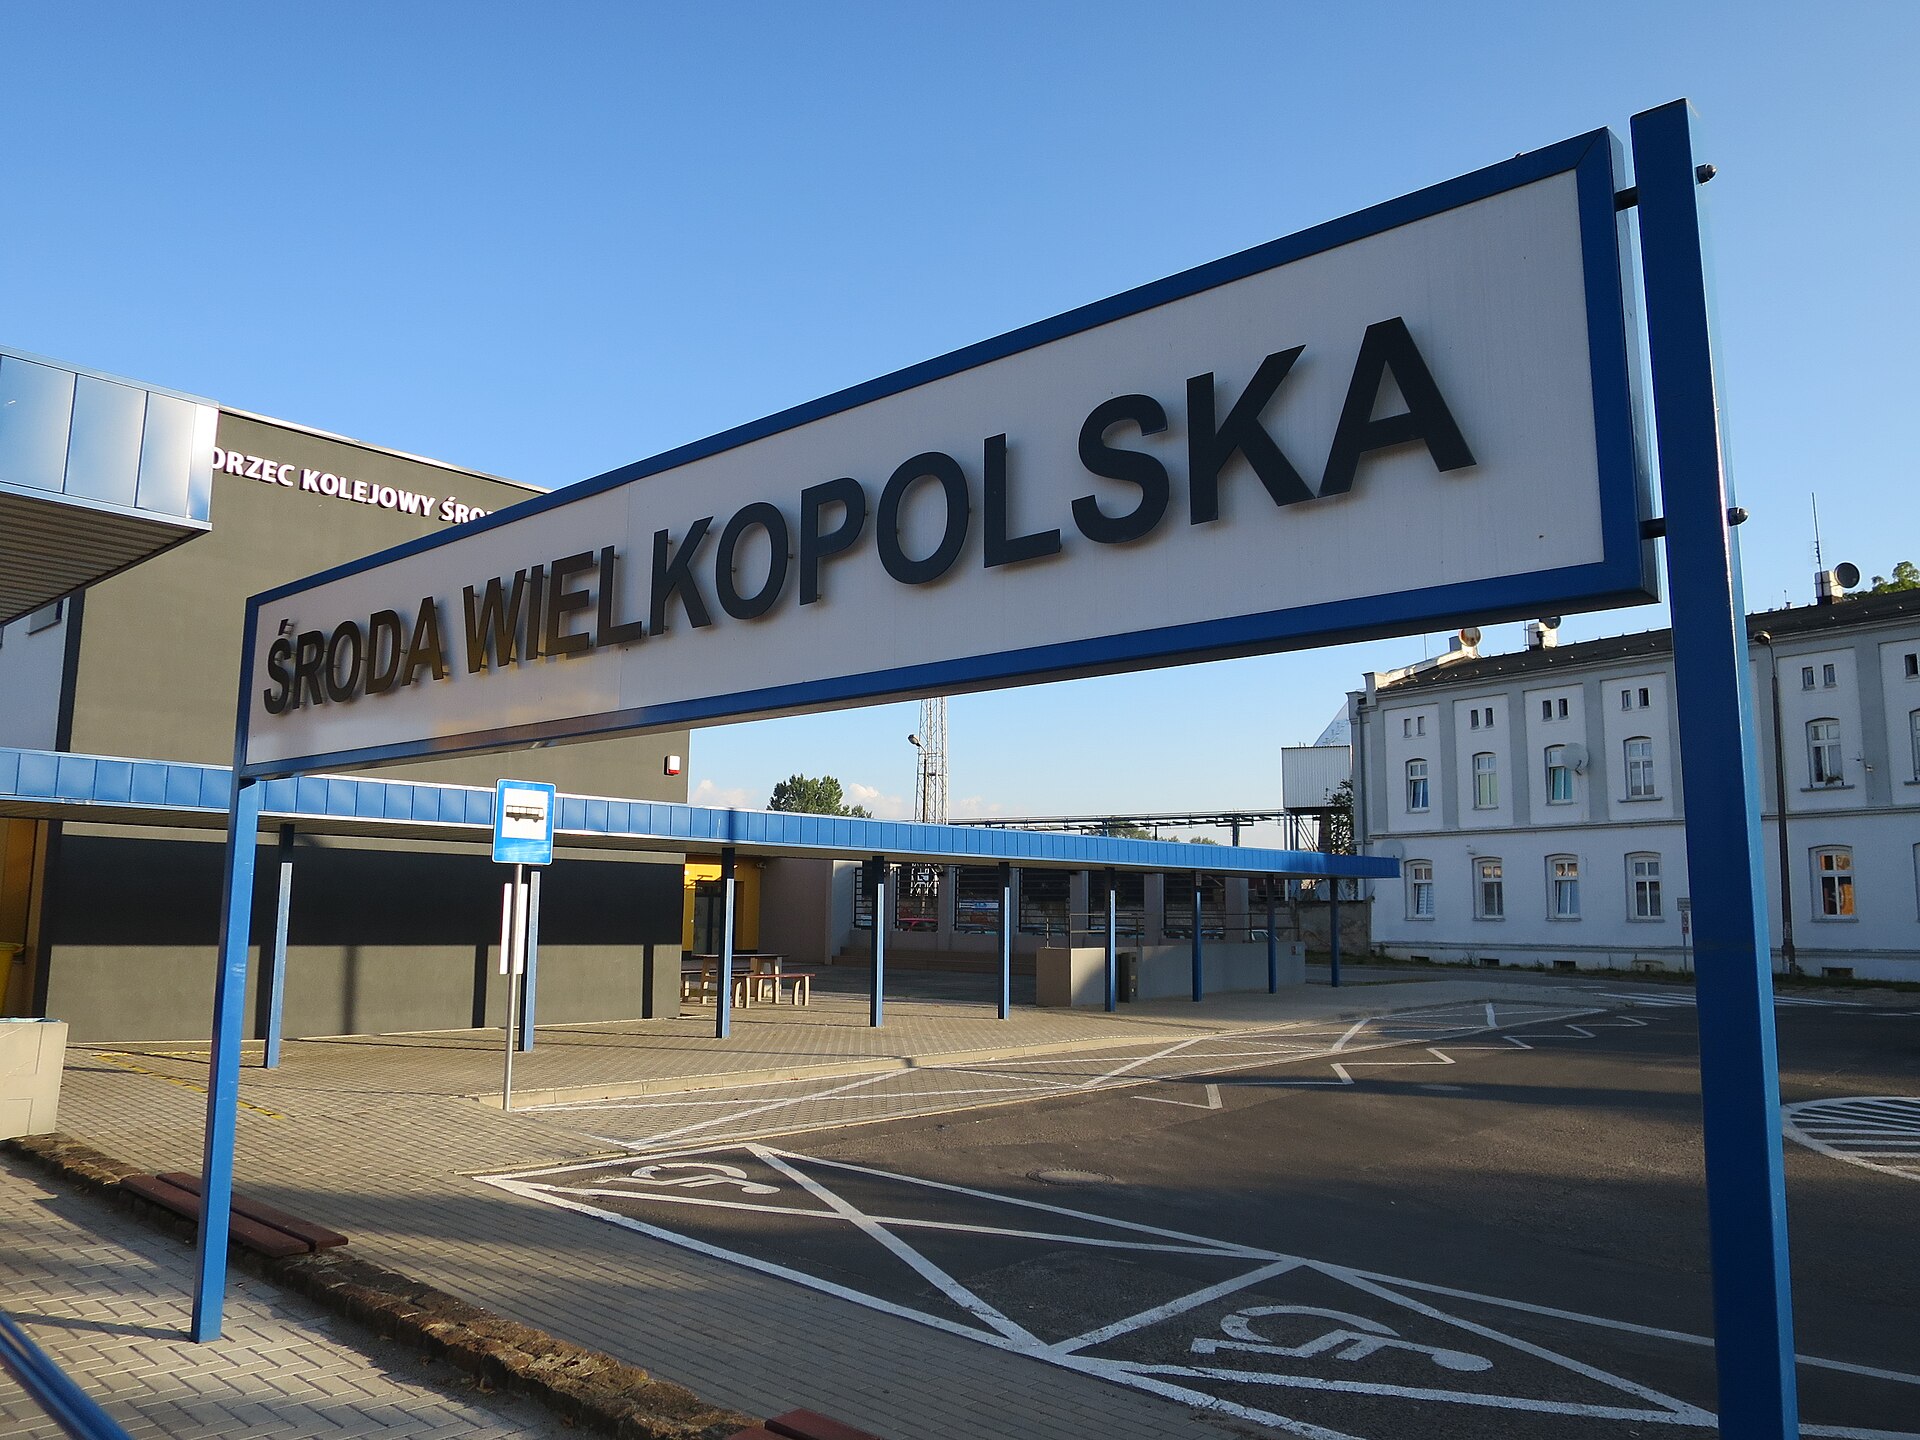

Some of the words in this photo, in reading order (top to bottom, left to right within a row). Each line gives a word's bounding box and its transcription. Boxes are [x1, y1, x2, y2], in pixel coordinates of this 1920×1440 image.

[263, 596, 445, 715] ŚRODA
[462, 315, 1476, 674] WIELKOPOLSKA
[302, 469, 436, 517] KOLEJOWY
[440, 496, 494, 524] ŚRO
